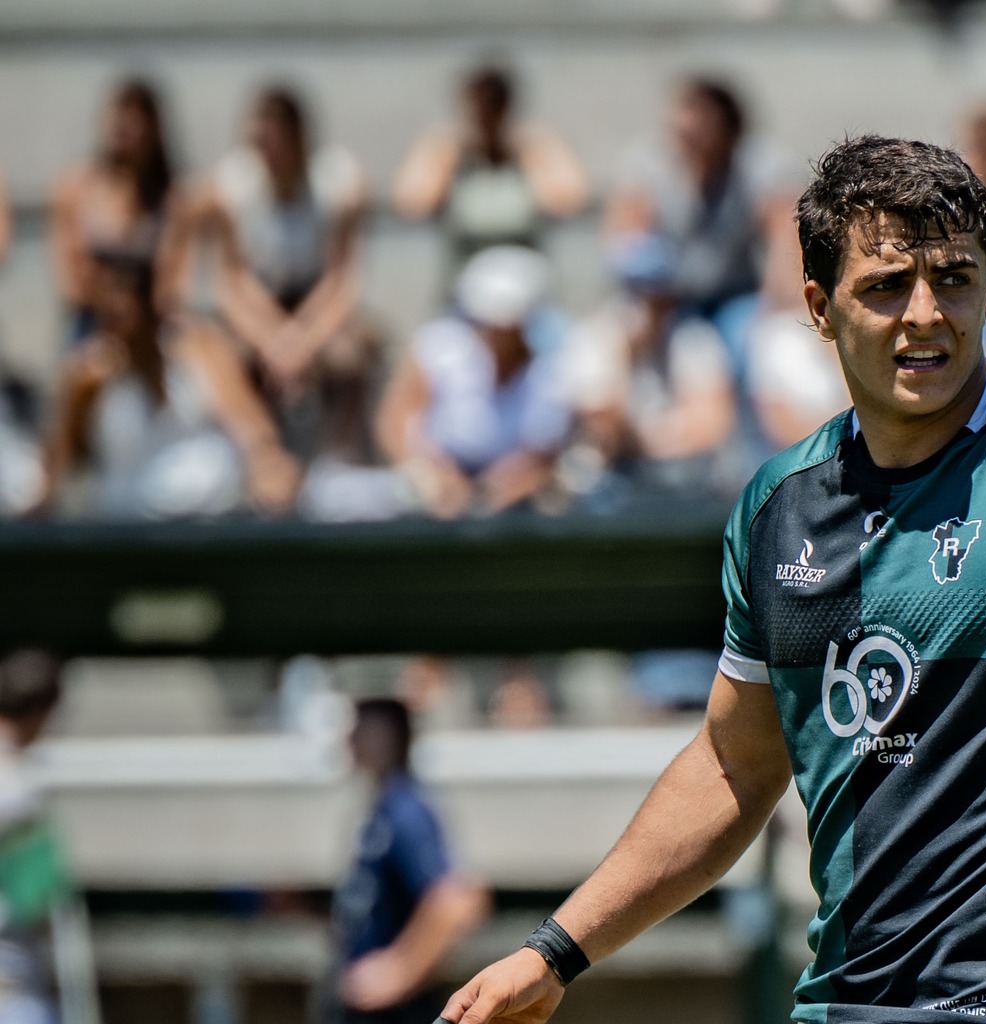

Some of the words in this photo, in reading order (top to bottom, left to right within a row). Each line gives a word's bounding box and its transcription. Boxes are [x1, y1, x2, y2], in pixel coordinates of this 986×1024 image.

[942, 537, 960, 557] R
[776, 563, 826, 582] RAYSER
[863, 621, 907, 645] anniversary
[905, 641, 921, 664] 1964
[822, 636, 913, 738] 60
[910, 670, 921, 696] 2024
[877, 751, 914, 768] Group
